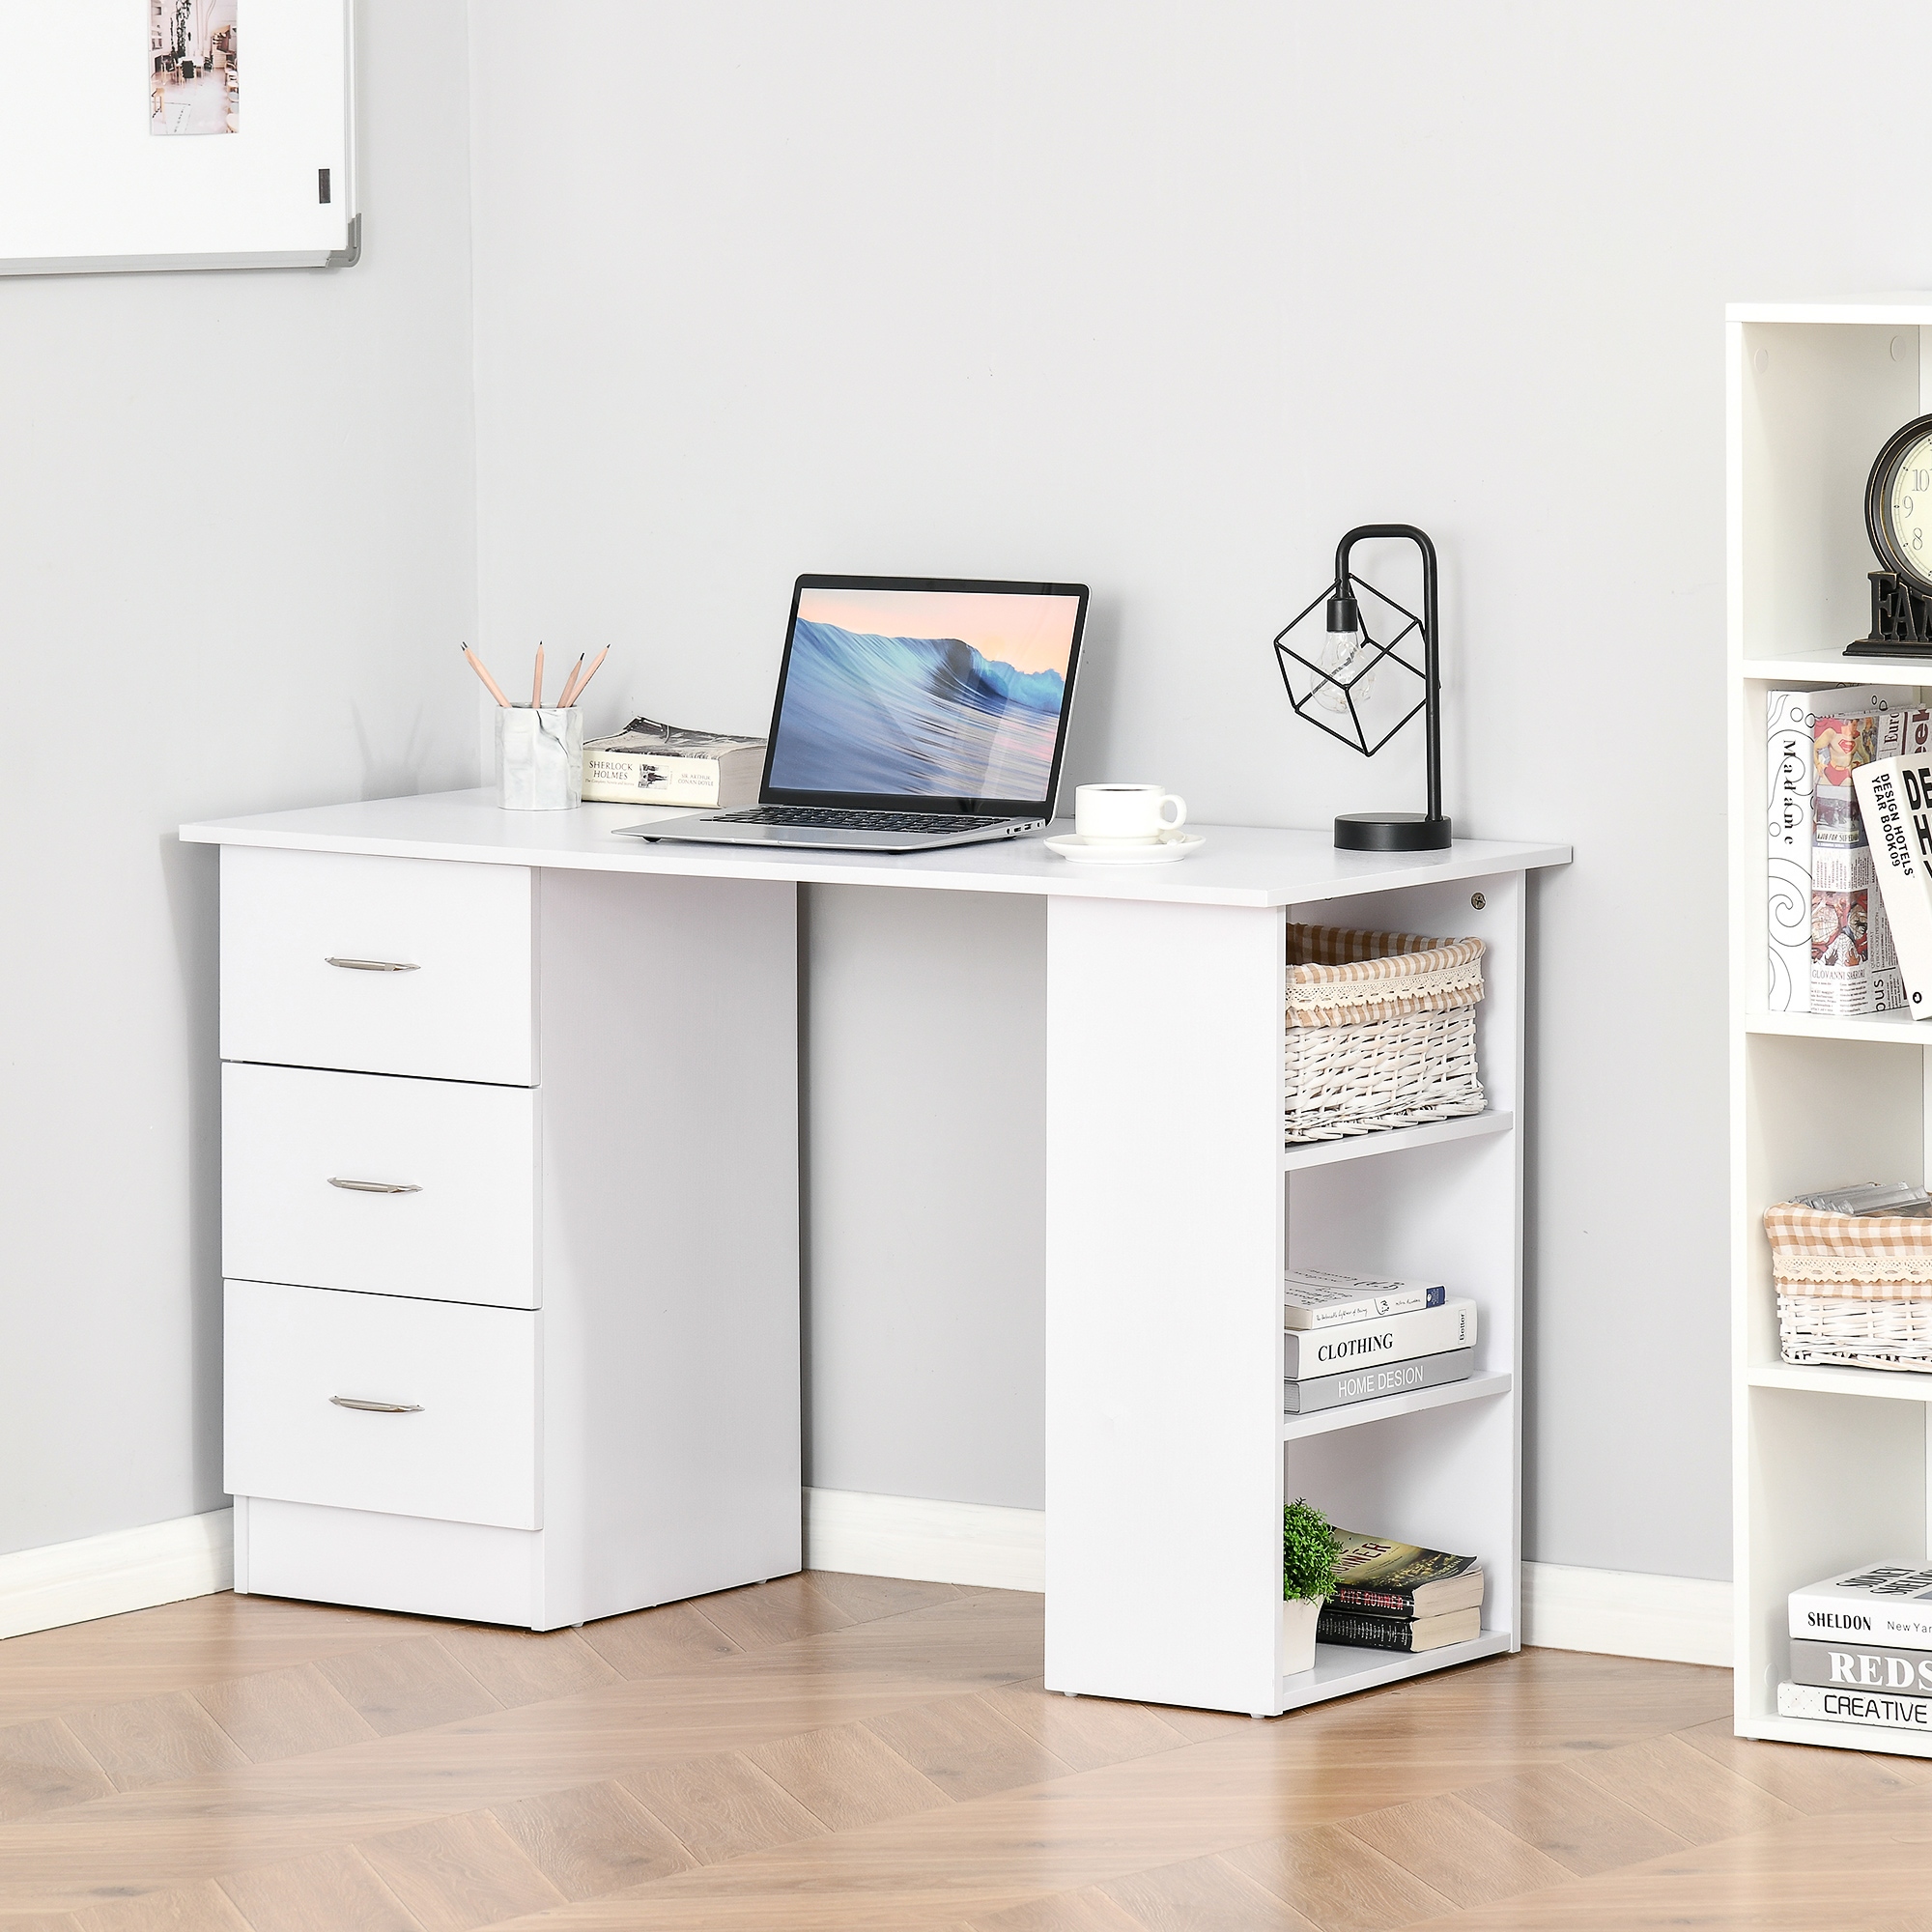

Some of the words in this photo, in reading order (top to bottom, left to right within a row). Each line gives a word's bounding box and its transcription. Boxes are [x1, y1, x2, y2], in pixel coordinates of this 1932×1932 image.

[1912, 469, 1930, 493] 10
[1903, 496, 1914, 519] 9
[1913, 527, 1923, 552] 8
[589, 760, 633, 771] SHERLOCK
[593, 770, 628, 780] HOLMES
[1783, 739, 1797, 845] Madame
[1872, 776, 1887, 811] YEAR
[1881, 773, 1900, 821] DESIGN
[1894, 826, 1914, 876] HOTELS
[1318, 1333, 1393, 1362] CLOTHING
[1338, 1375, 1375, 1398] HOME
[1363, 1591, 1404, 1610] RUNNER
[1807, 1612, 1871, 1631] SHELDON
[1888, 1621, 1911, 1632] New
[1825, 1694, 1927, 1723] CREATIVE
